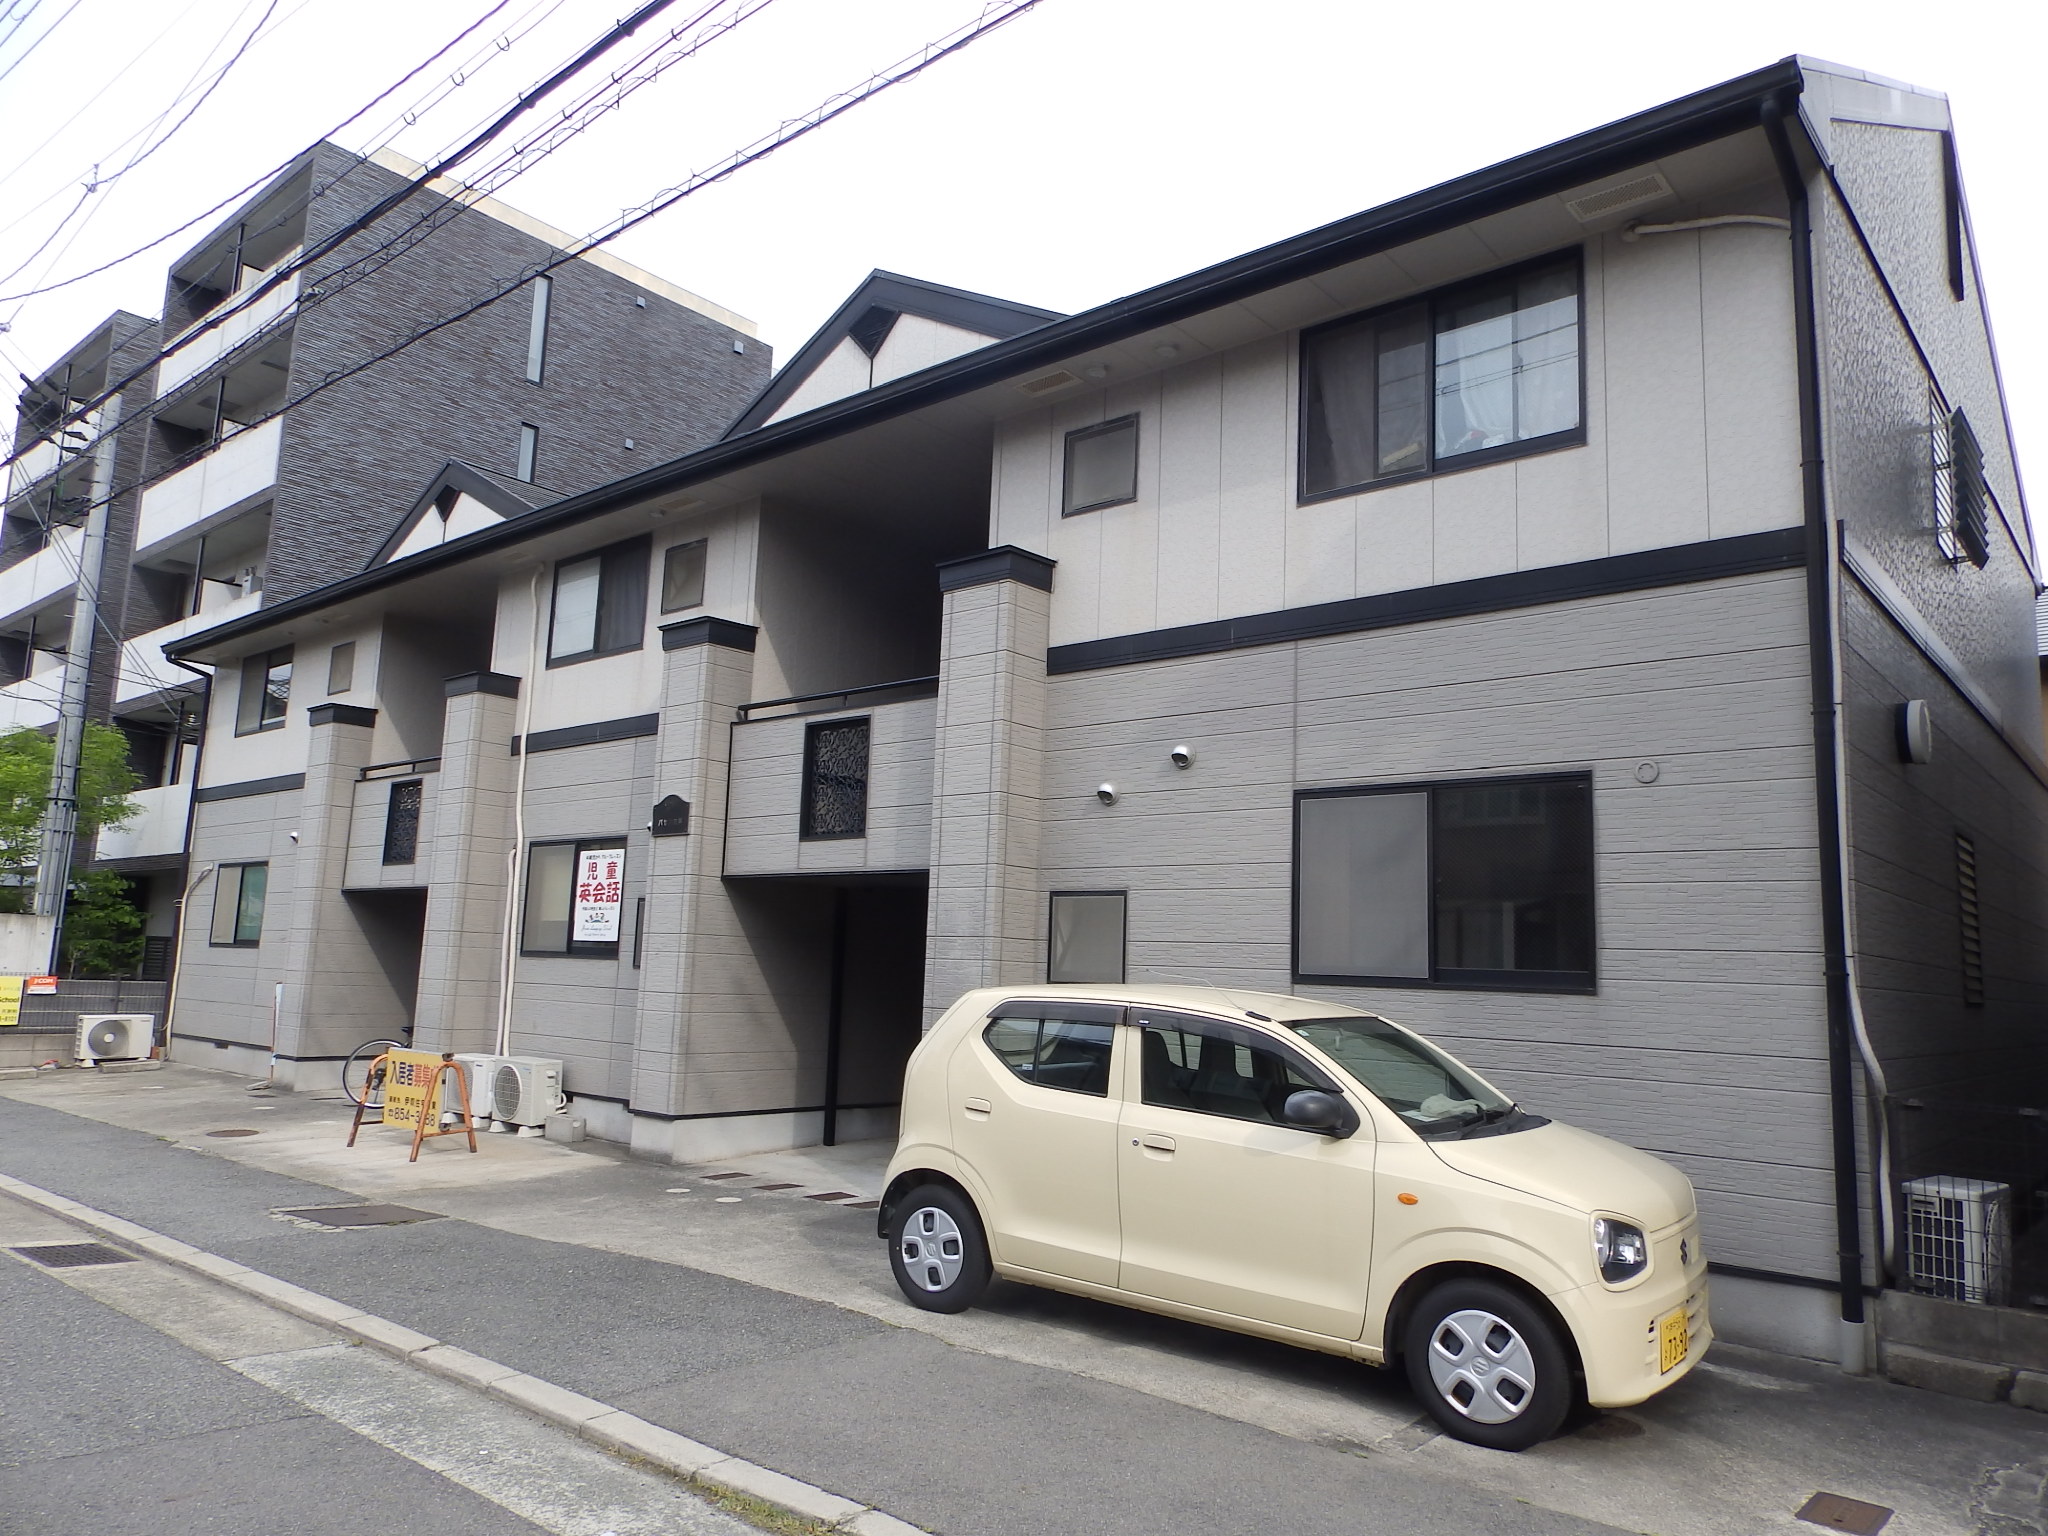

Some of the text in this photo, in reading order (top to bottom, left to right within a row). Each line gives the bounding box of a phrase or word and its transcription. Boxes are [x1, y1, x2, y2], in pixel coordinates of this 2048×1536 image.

[587, 861, 618, 880] 児童
[579, 882, 620, 903] 英会話
[389, 1061, 440, 1088] 入居者募集
